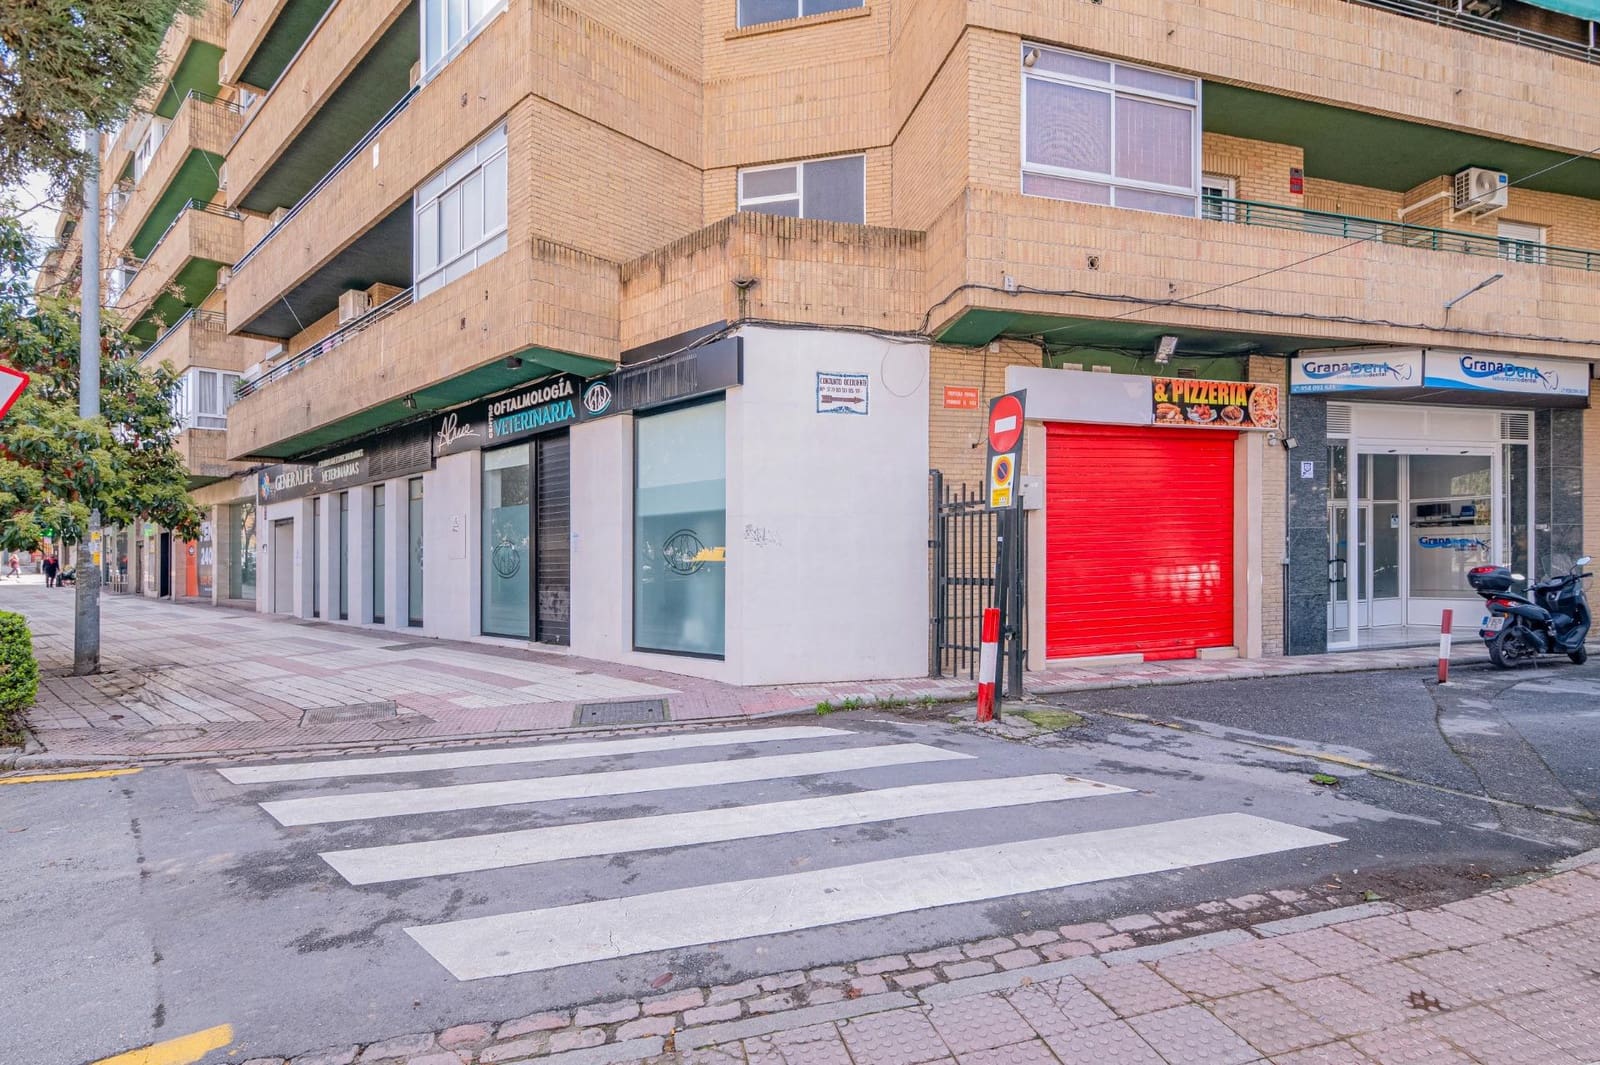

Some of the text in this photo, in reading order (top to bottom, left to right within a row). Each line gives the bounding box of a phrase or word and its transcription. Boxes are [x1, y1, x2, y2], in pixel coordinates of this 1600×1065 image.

[1304, 361, 1389, 375] GranaDent
[1461, 356, 1538, 378] GranaDent
[493, 378, 573, 416] OFTALMOLOGÍA
[1154, 380, 1247, 406] & PIZZERIA
[493, 400, 575, 437] VETERINARIA
[275, 466, 314, 491] GENERALIFE
